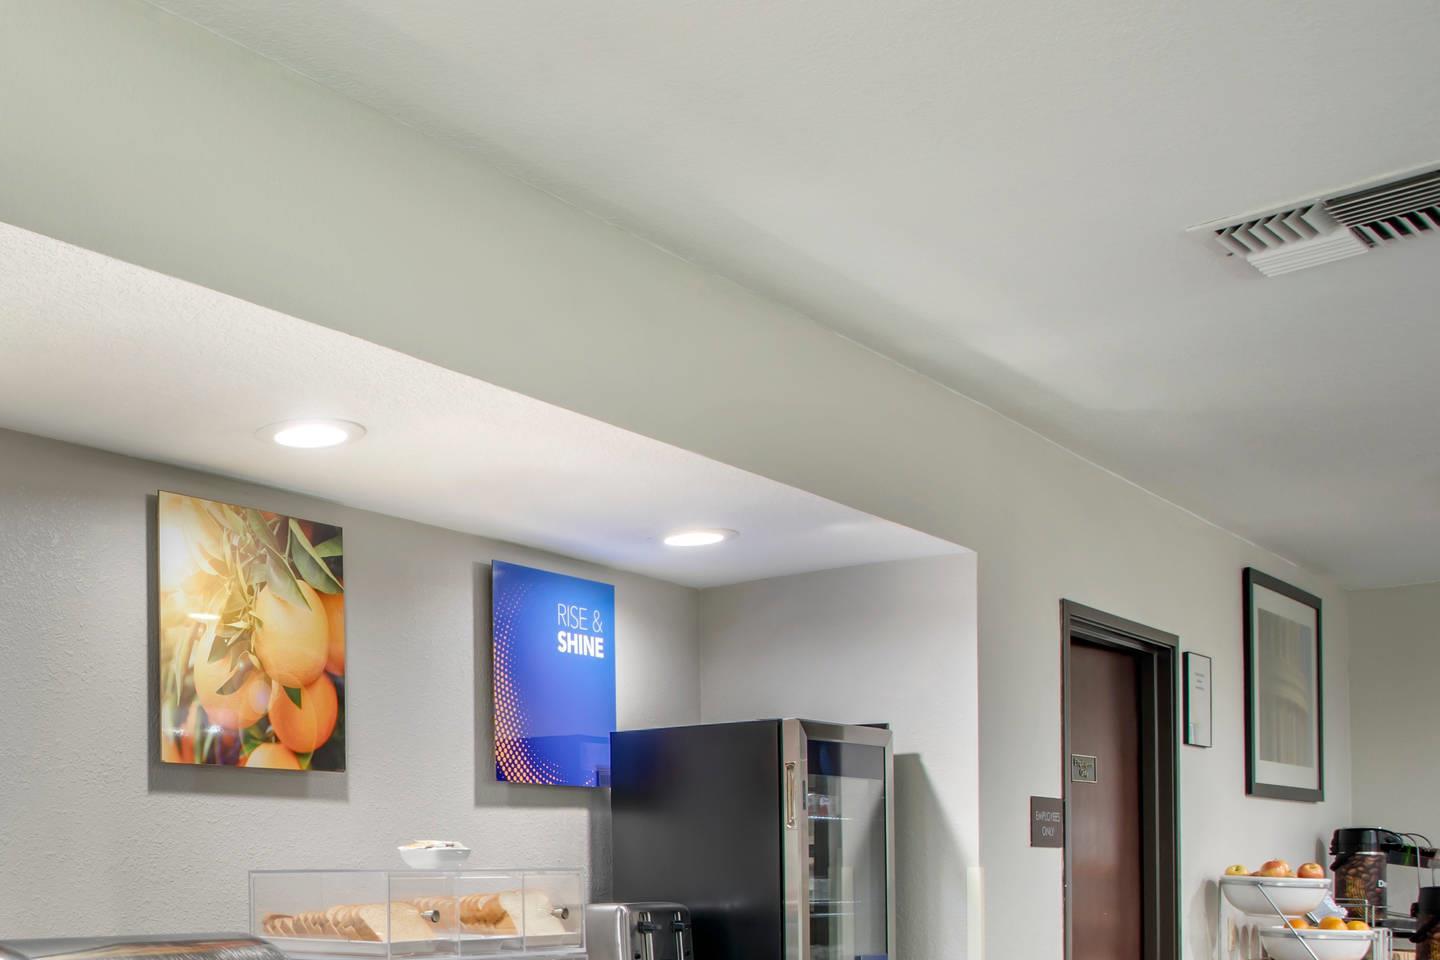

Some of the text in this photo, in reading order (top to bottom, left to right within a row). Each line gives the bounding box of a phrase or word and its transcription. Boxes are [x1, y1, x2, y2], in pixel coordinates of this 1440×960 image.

[557, 603, 603, 633] RISE &
[557, 630, 605, 658] SHINE
